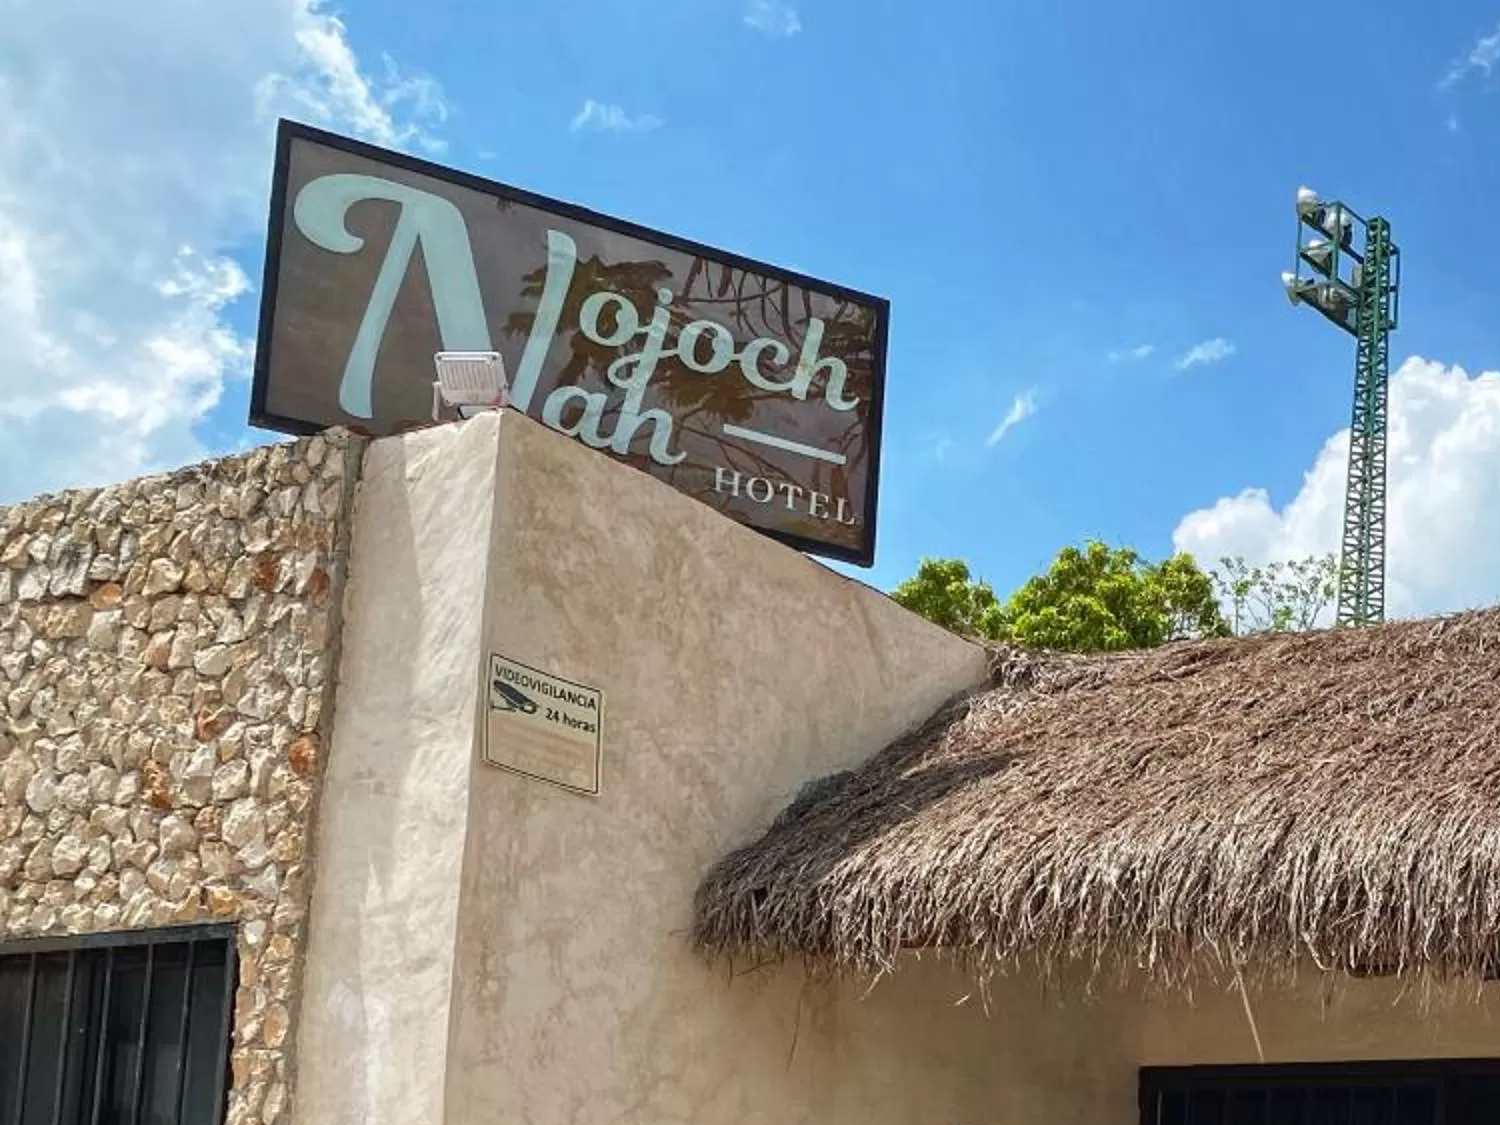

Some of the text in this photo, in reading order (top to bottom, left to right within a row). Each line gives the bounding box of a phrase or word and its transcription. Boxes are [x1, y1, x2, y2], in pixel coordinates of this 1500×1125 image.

[714, 467, 857, 526] HOTEL
[495, 663, 597, 711] VIDEOVIGILANCIA
[545, 707, 596, 733] 24 horas
